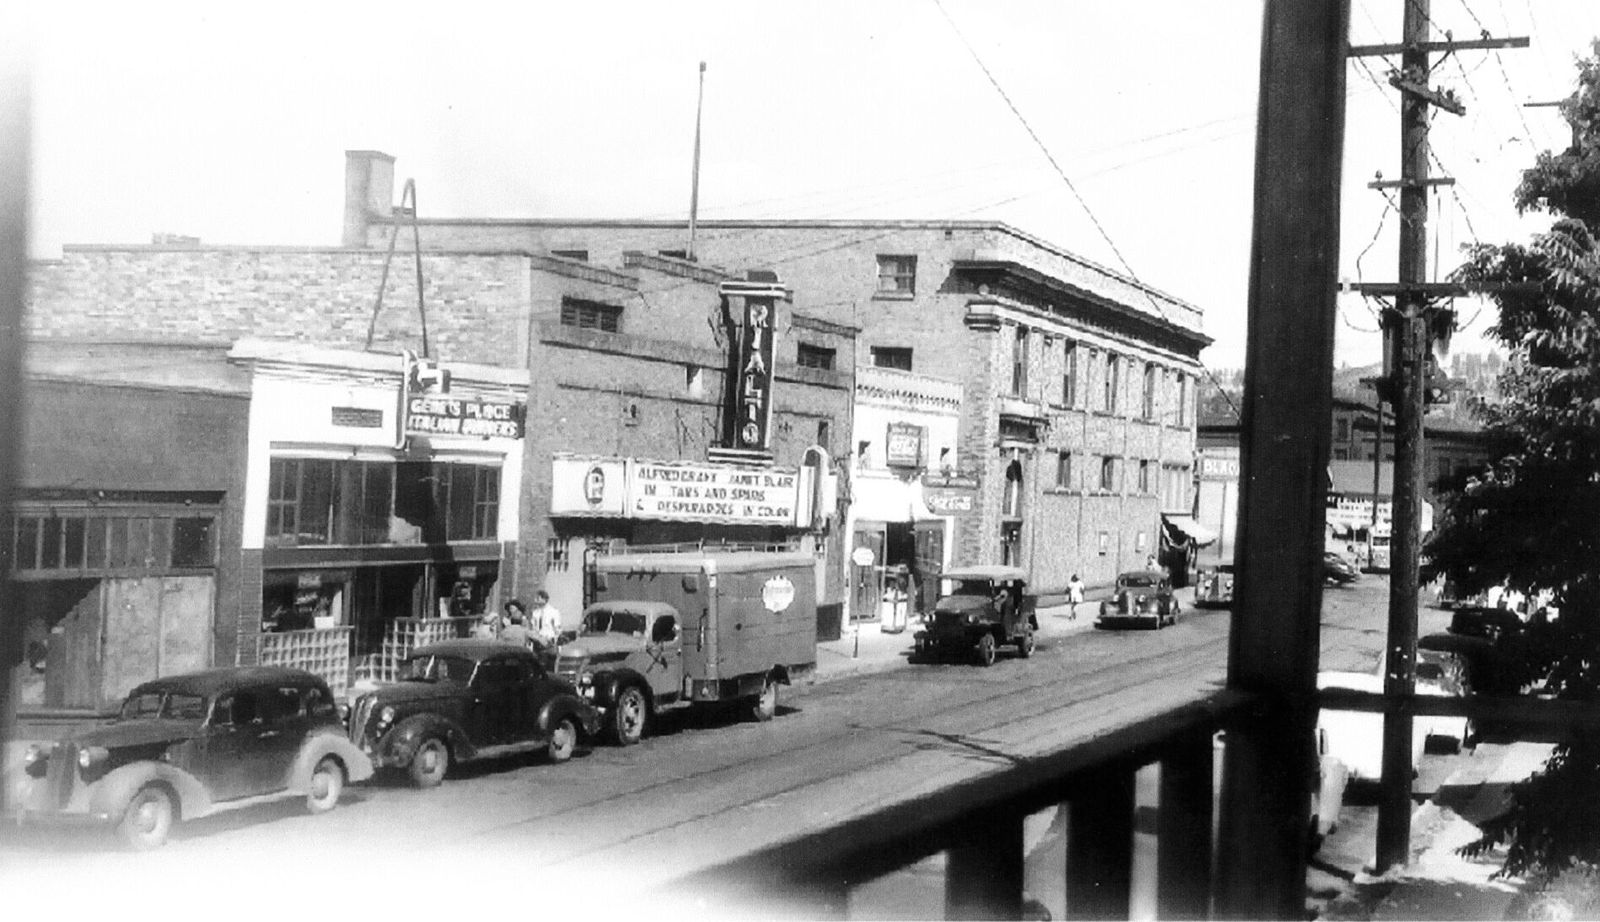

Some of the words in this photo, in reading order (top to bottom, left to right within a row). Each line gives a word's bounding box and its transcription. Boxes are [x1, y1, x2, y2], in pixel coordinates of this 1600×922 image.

[742, 304, 768, 444] RIALTO
[410, 400, 461, 416] GENE'S
[466, 403, 511, 420] PLACE
[408, 415, 460, 435] ITALIAN
[461, 418, 519, 439] DINNERS
[764, 475, 794, 488] BLAIR
[644, 484, 657, 496] IN
[669, 485, 700, 498] TARS
[704, 487, 727, 499] AND
[730, 488, 765, 502] SPARS
[742, 505, 753, 517] IN
